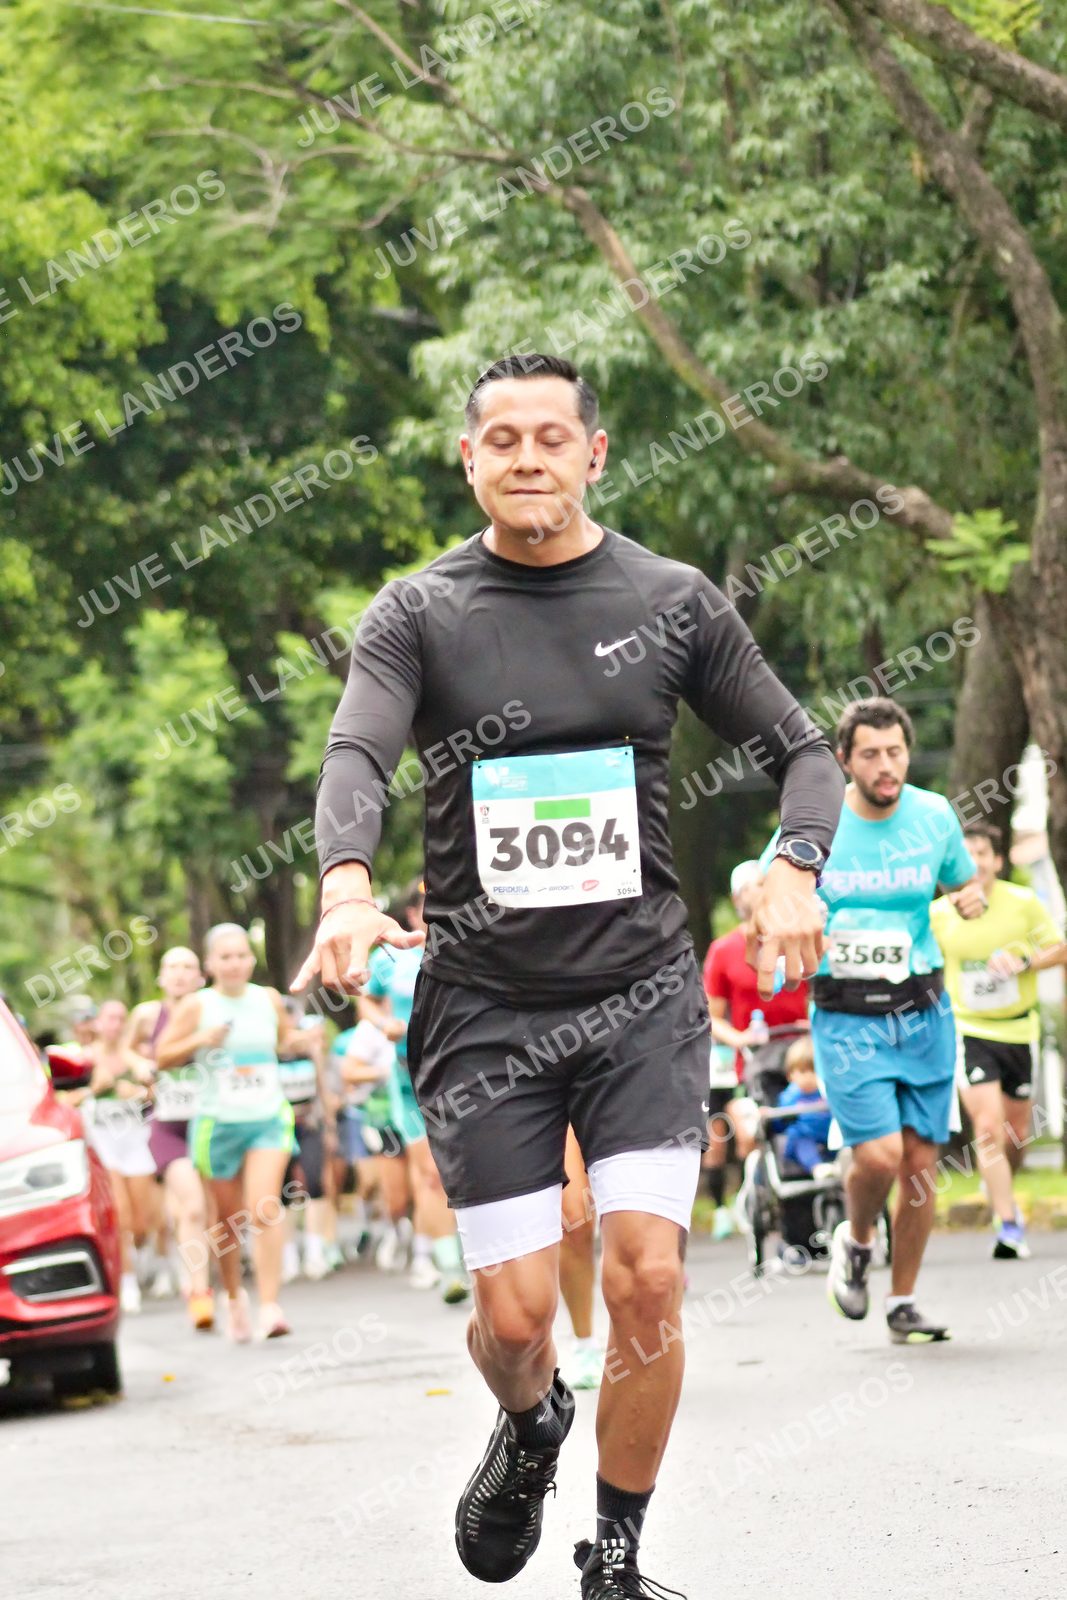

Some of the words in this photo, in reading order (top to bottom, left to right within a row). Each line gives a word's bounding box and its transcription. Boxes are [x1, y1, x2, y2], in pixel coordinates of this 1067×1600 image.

[489, 818, 630, 872] 3094
[493, 886, 529, 894] PERDURA
[822, 865, 933, 893] PERDURA
[617, 887, 637, 896] 3094
[835, 943, 904, 965] 3563
